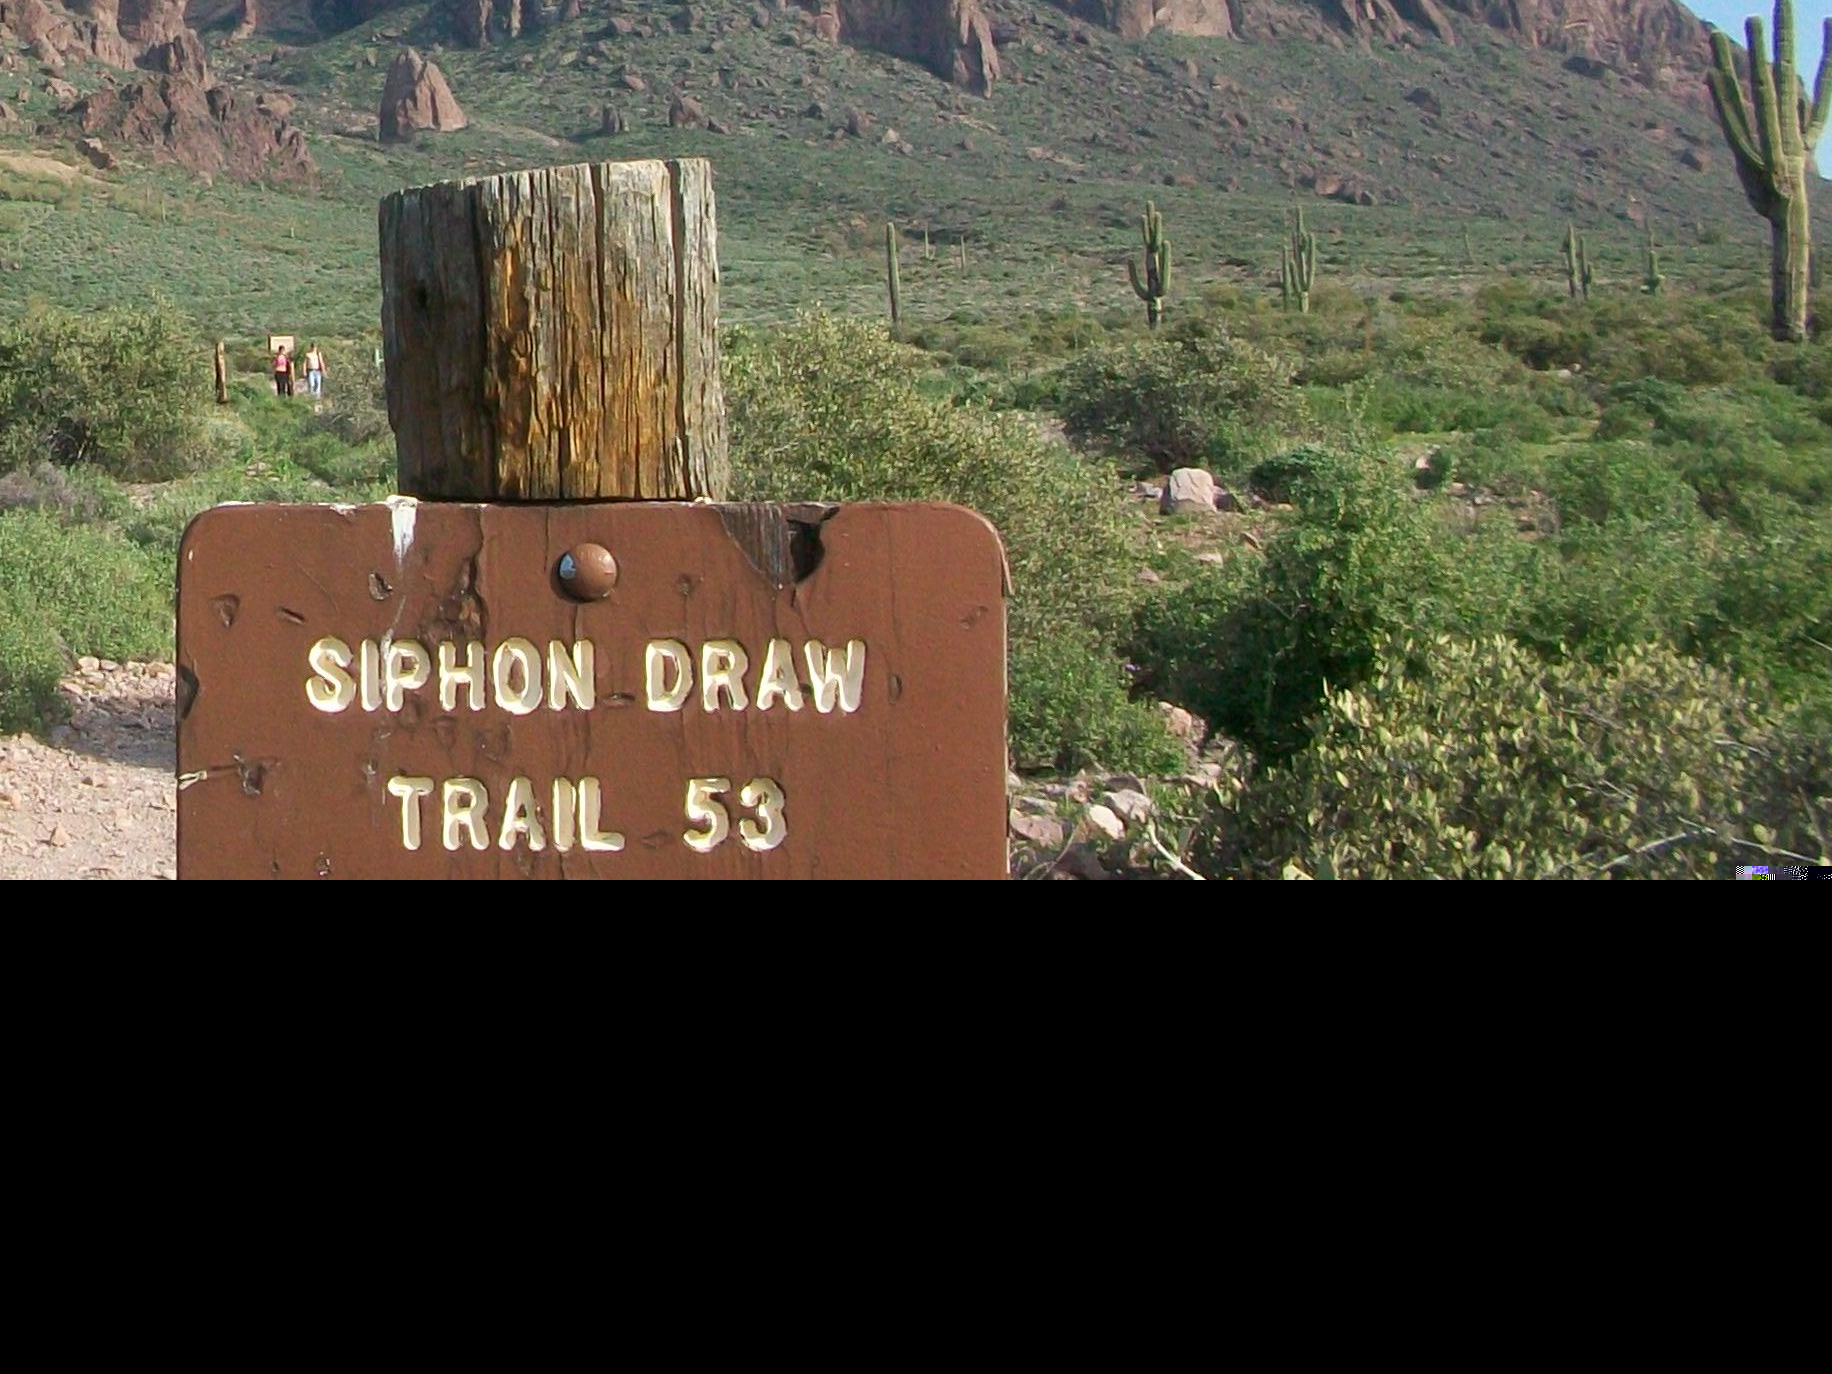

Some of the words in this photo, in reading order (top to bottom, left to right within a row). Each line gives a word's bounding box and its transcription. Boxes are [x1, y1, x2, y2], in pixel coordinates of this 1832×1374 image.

[305, 636, 596, 715] SIPHON
[645, 637, 867, 714] DRAW
[387, 776, 626, 852] TRAIL
[682, 777, 788, 852] 53
